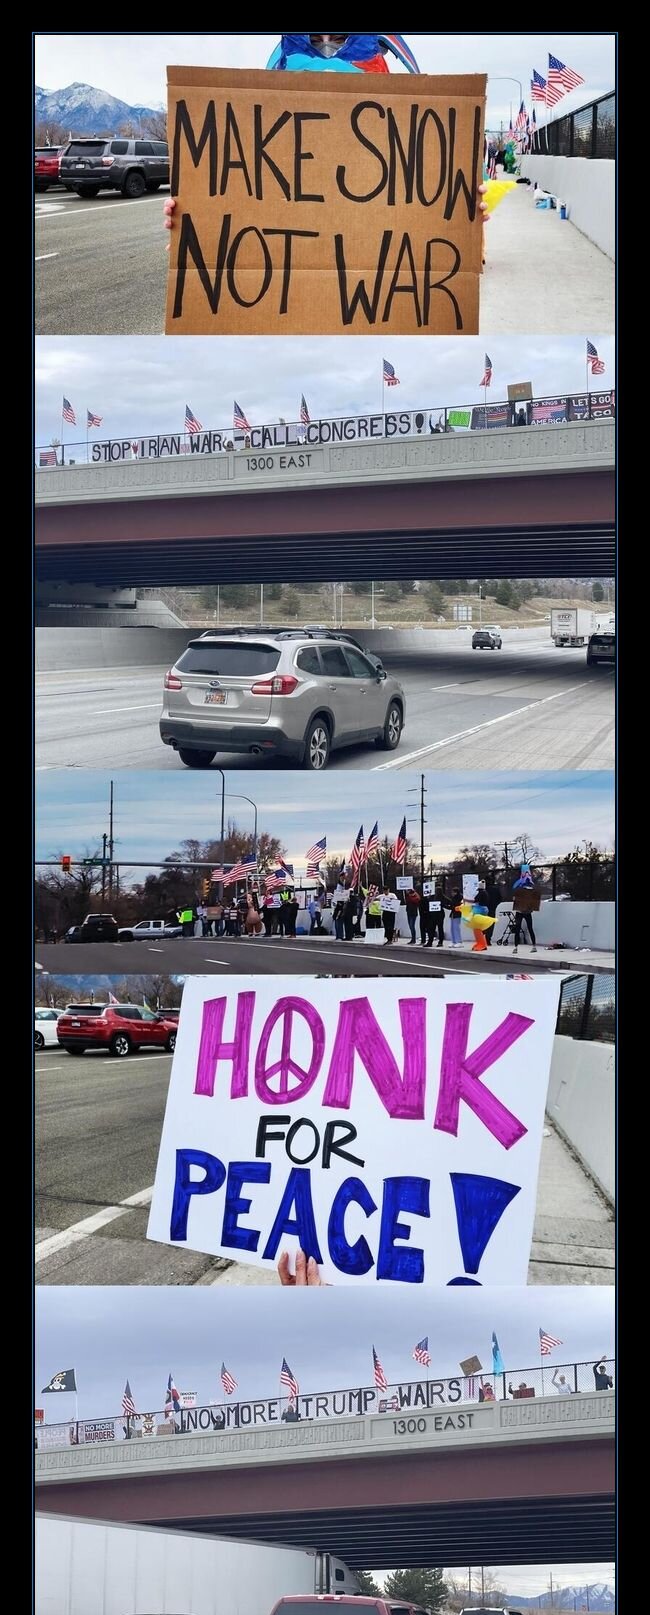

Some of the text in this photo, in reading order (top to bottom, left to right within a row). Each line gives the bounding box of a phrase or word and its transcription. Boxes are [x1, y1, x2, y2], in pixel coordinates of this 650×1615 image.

[170, 99, 481, 223] MAKE SNOW
[172, 213, 464, 331] NOT WAR
[530, 417, 568, 425] AMERICA
[598, 395, 611, 404] GO
[92, 441, 131, 461] STOP
[140, 436, 181, 457] IRAN
[189, 433, 222, 454] WAR
[250, 425, 297, 448] CALL
[307, 412, 425, 444] CONGRESS!
[246, 454, 312, 471] 1300 EAST
[194, 991, 535, 1150] HONK
[255, 1114, 365, 1169] FOR
[169, 1148, 522, 1285] PEACE!
[187, 1407, 211, 1431] NO
[225, 1401, 278, 1427] MORE
[302, 1389, 376, 1418] TRUMP
[393, 1413, 474, 1434] 1300 EAST
[85, 1430, 115, 1441] MURDERS
